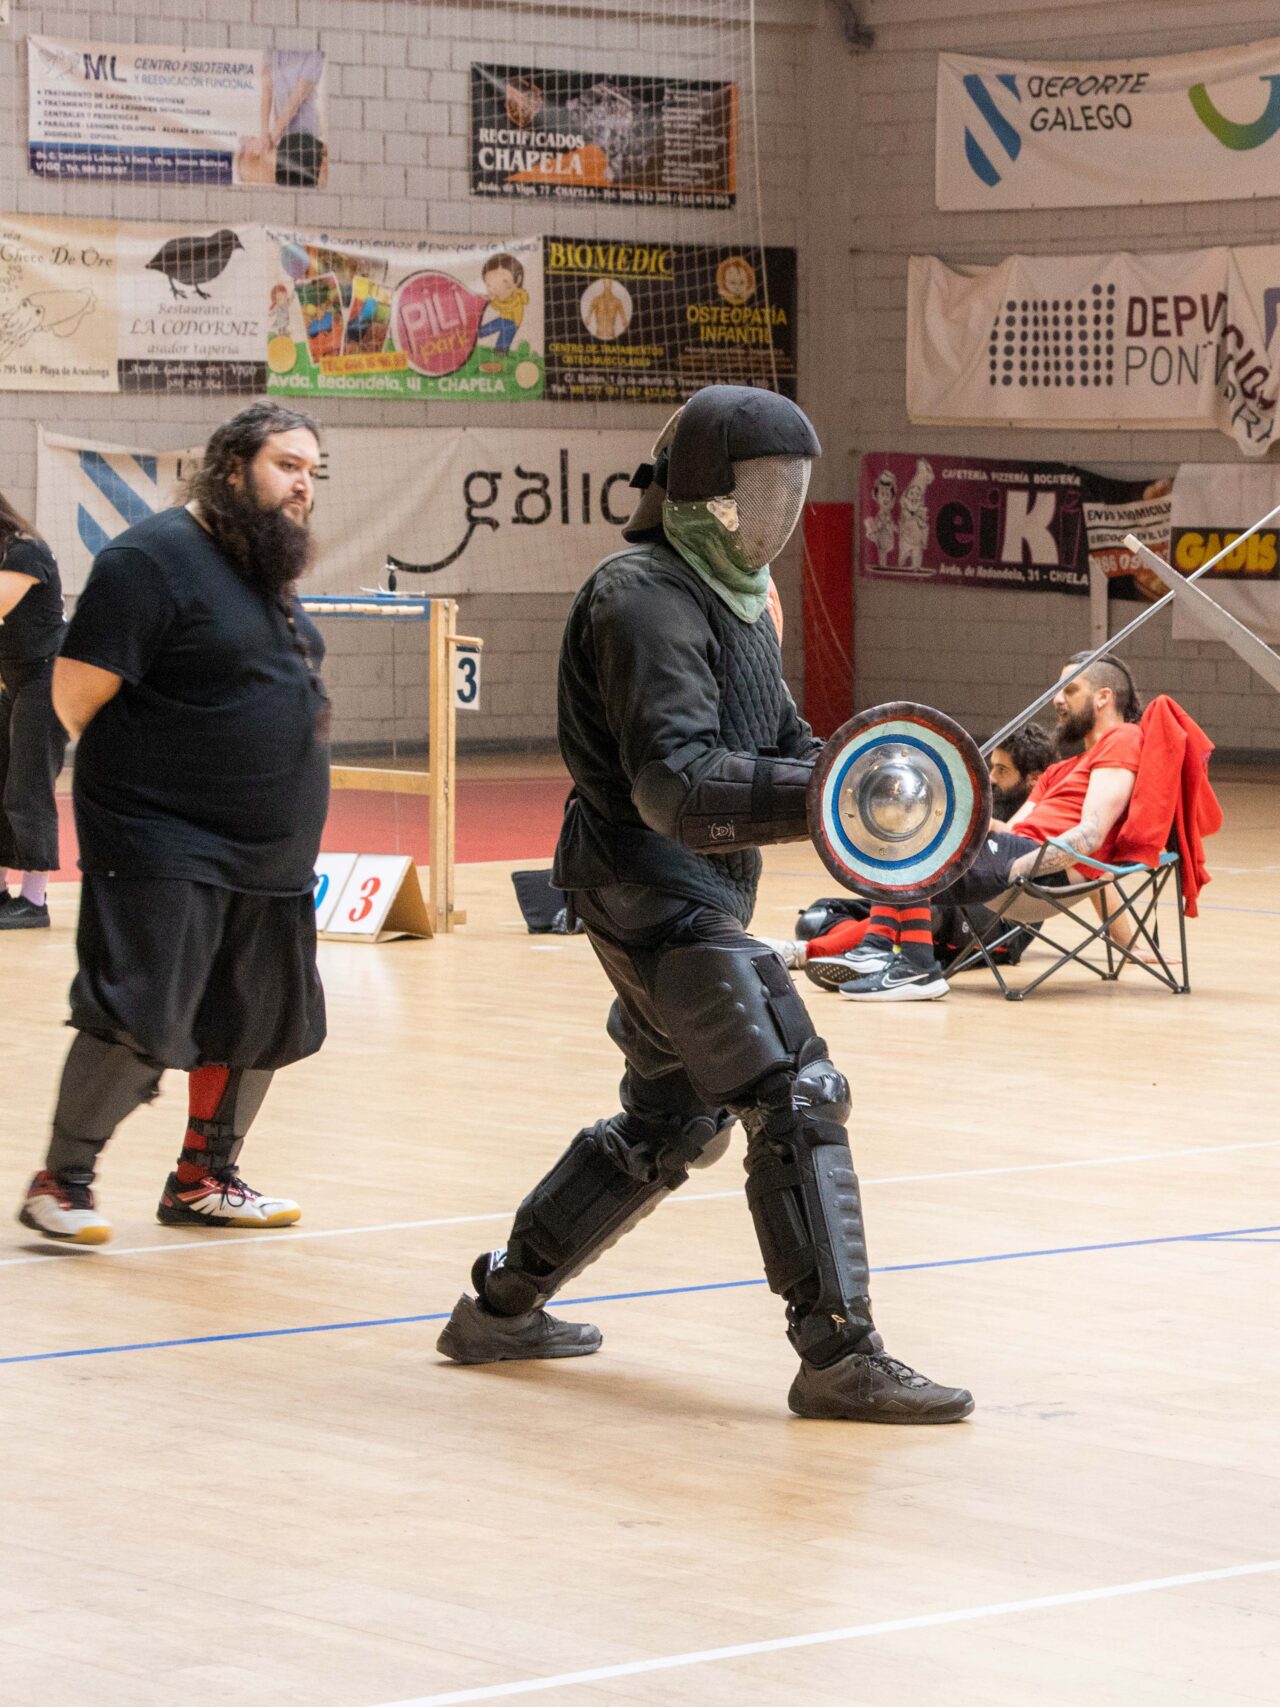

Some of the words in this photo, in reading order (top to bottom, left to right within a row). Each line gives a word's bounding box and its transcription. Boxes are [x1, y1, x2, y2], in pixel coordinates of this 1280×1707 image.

[83, 53, 127, 83] ML
[134, 57, 182, 72] CENTRO
[182, 60, 255, 75] FISIOTERAPIA
[205, 77, 255, 89] FUNCIONAL
[1027, 71, 1151, 100] DEPORTE
[1029, 104, 1131, 132] GALEGO
[479, 127, 585, 149] RECTIFICADOS
[478, 147, 583, 175] CHAPELA
[550, 243, 677, 275] BIOMEDIC
[157, 303, 232, 316] Restaurante
[686, 304, 788, 325] OSTEOPATÍA
[129, 319, 156, 336] LA
[162, 319, 260, 338] CODORNIZ
[317, 373, 404, 393] Redondela,
[438, 378, 506, 393] CHAPELA
[1175, 532, 1279, 573] GADIS
[457, 657, 477, 704] 3
[348, 877, 382, 922] 3
